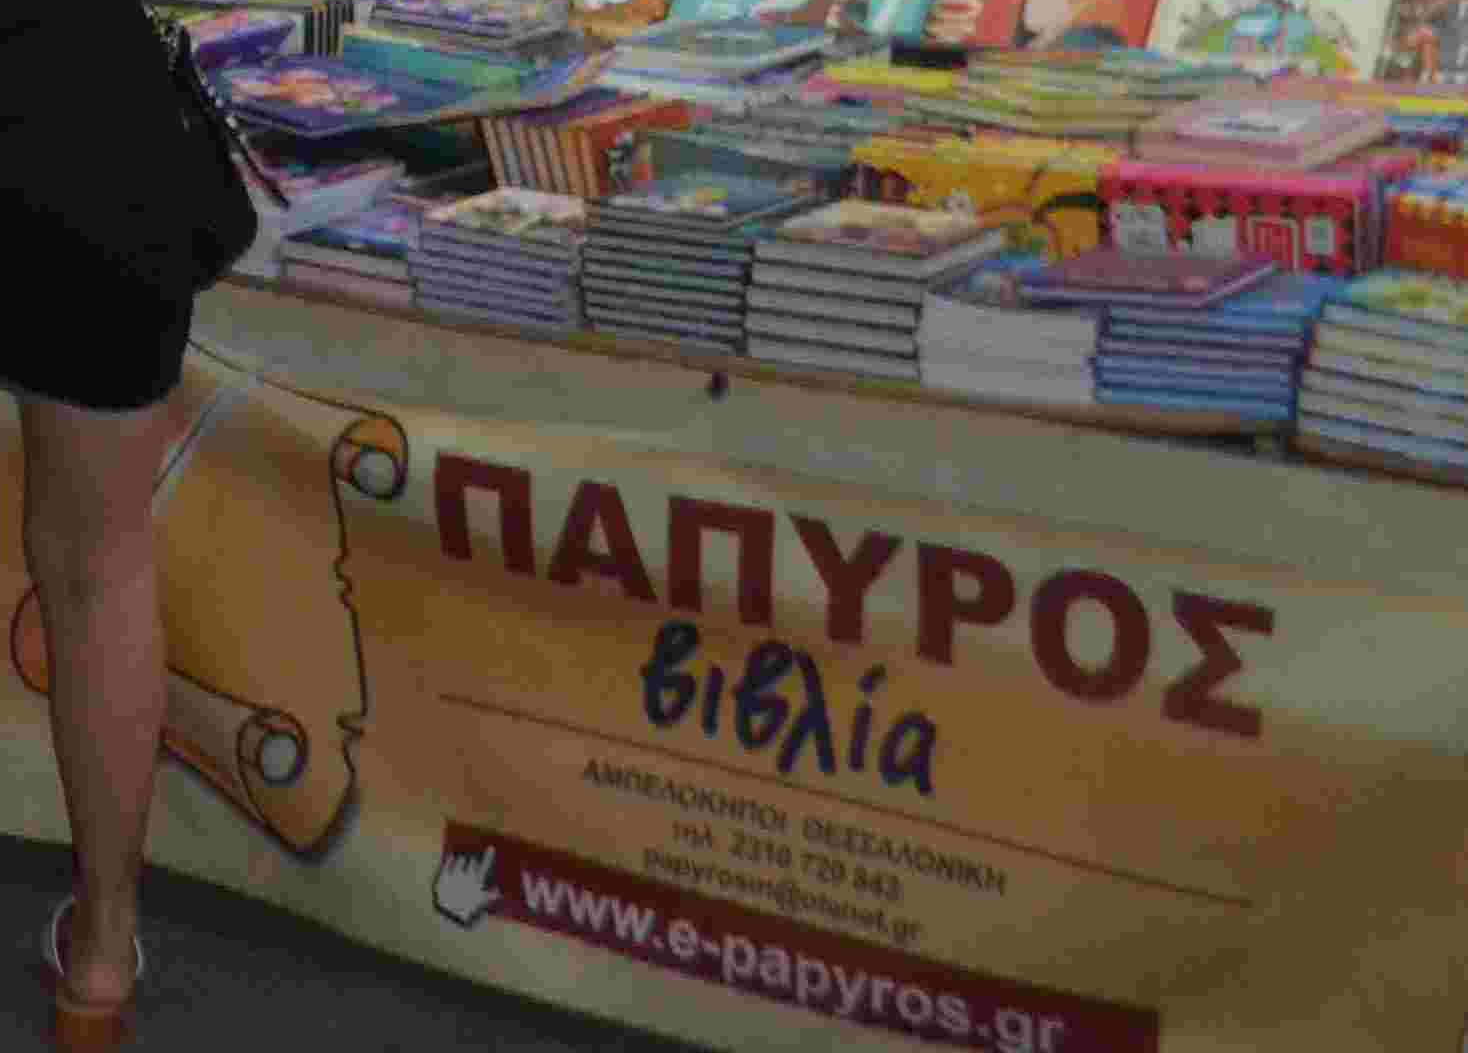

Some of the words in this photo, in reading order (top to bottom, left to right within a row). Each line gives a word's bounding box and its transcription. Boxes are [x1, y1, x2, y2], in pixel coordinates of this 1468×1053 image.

[434, 452, 1277, 739] ΠΑΠΥΡΟΣ
[642, 619, 938, 796] βιβλία
[581, 757, 788, 834] ΑΜΠΕΛΟΚΗΠΟΙ
[801, 816, 1008, 898] ΘΕΣΣΑΛΟΝΙΚΗ
[519, 867, 1067, 1053] www.e-papyros.gr
